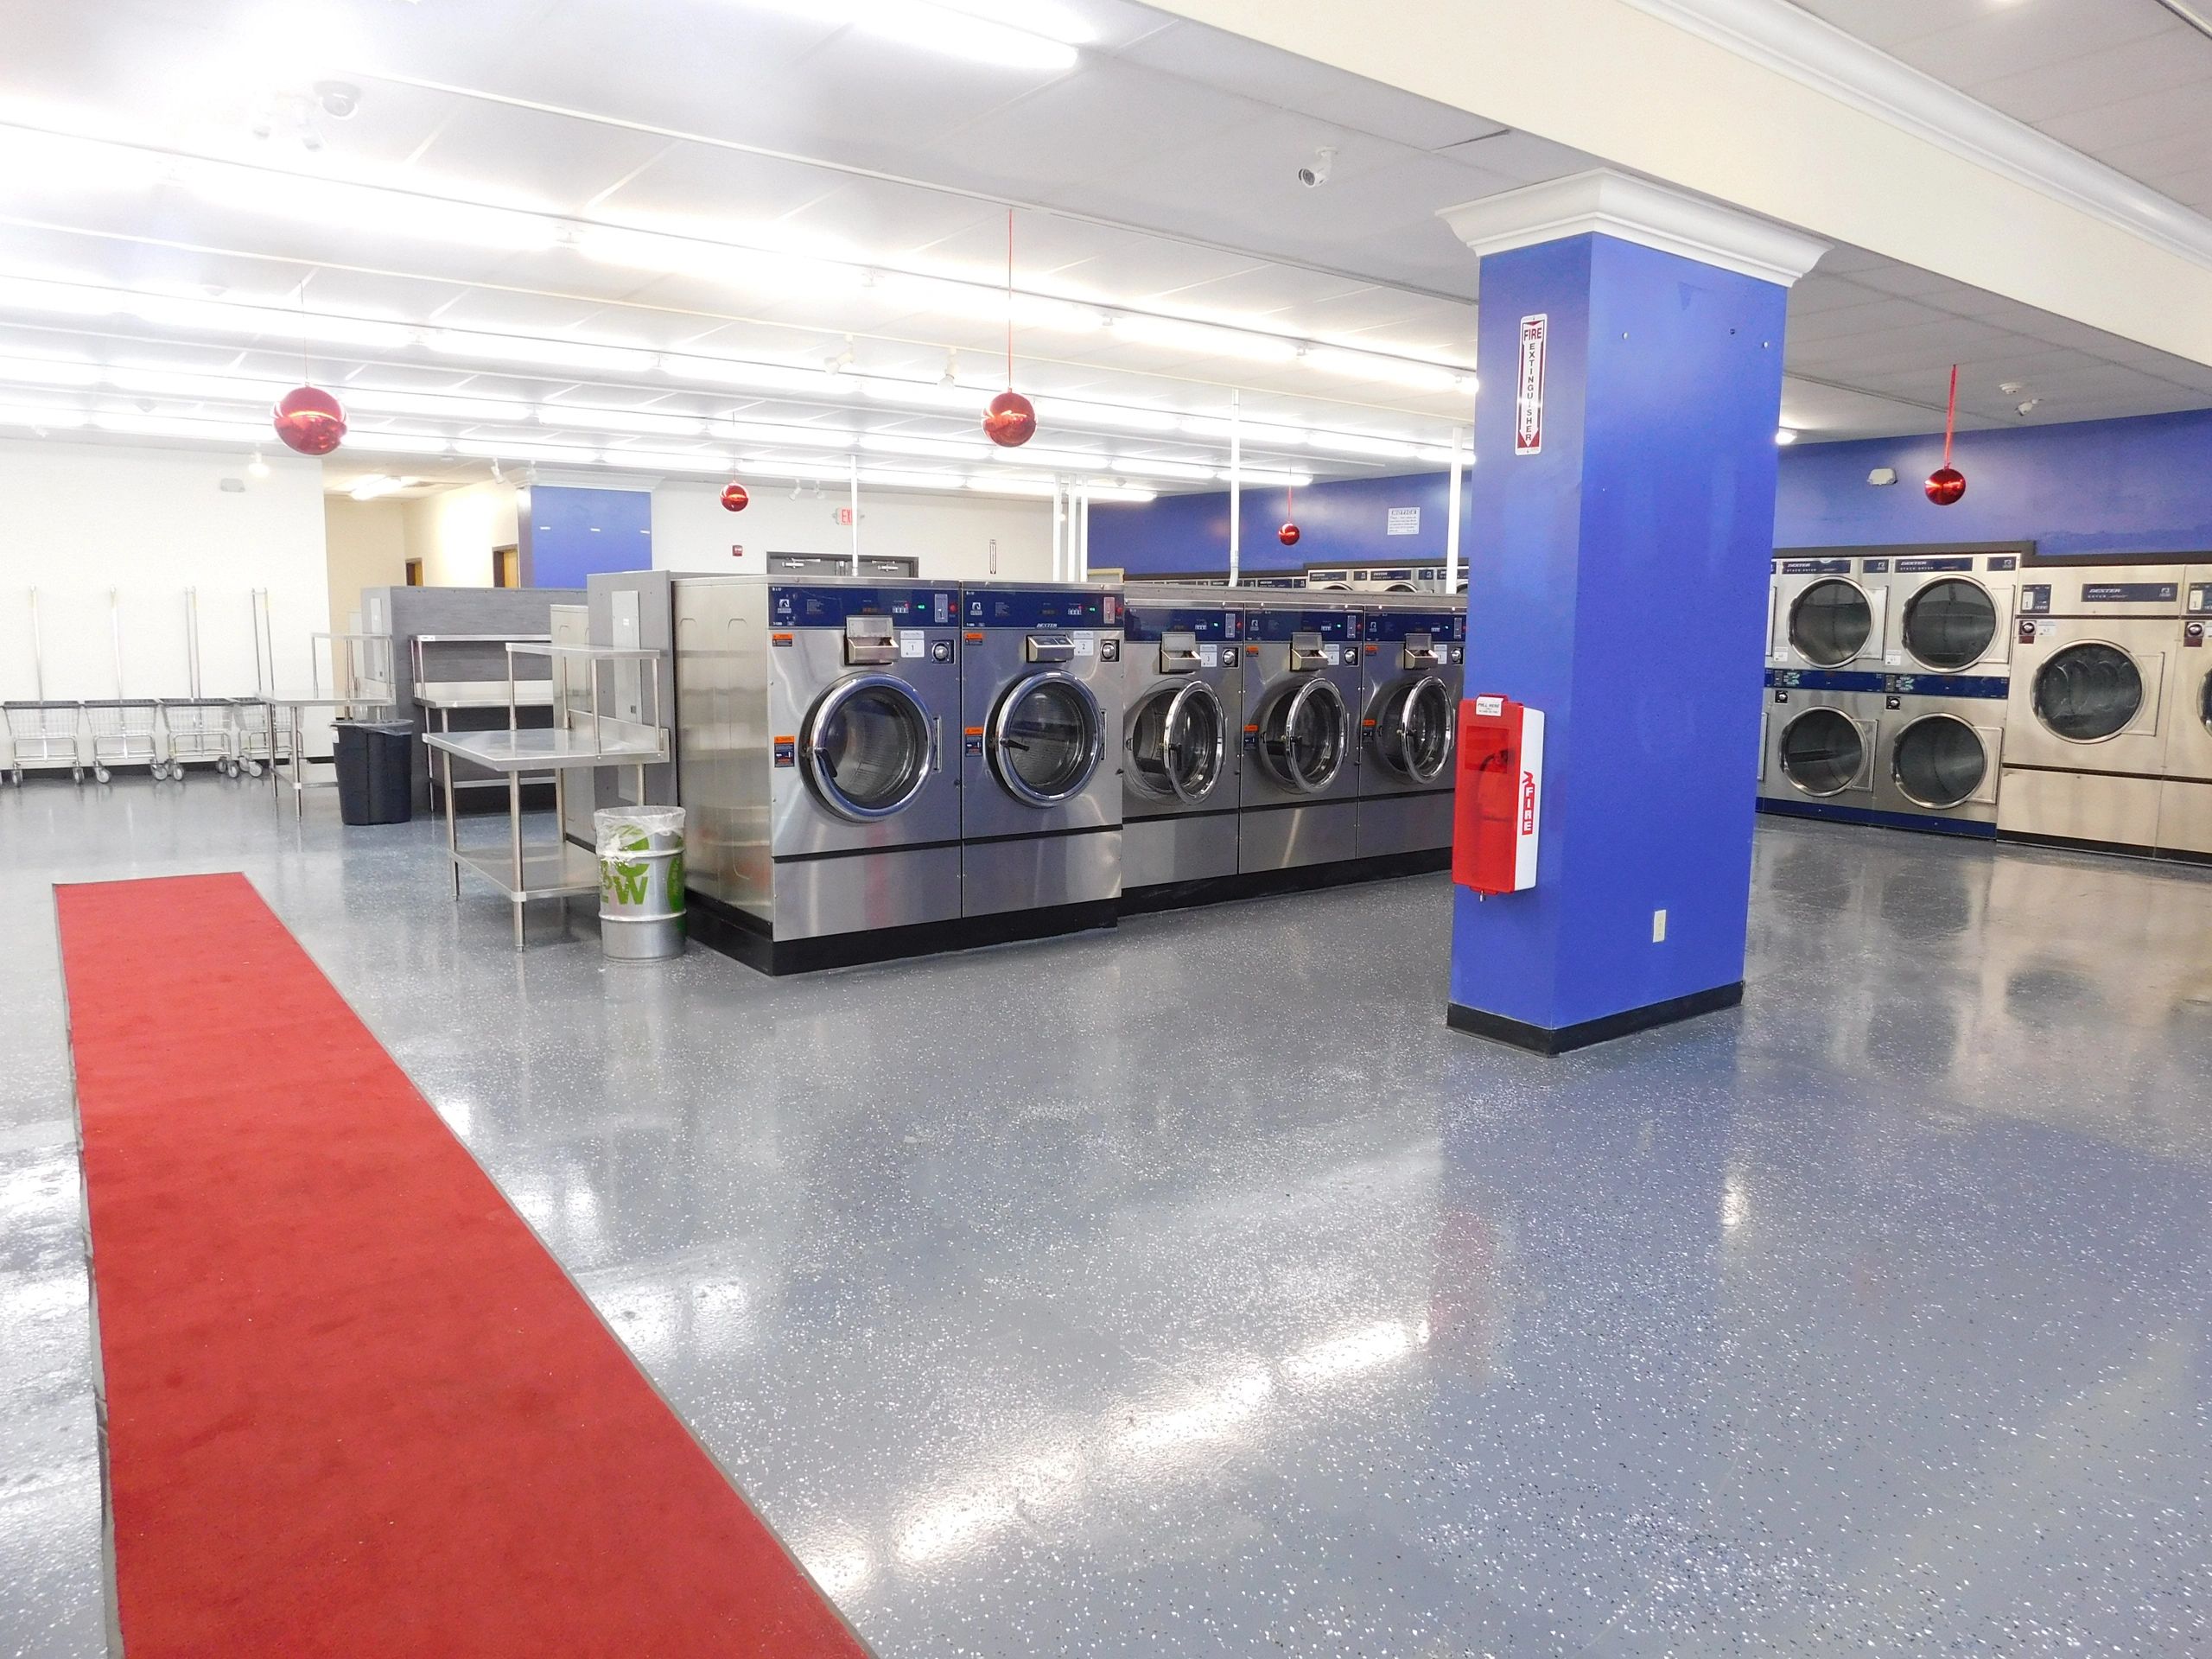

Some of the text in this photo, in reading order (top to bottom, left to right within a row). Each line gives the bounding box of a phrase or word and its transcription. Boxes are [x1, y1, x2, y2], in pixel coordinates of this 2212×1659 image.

[1523, 327, 1542, 341] FIRE
[1525, 342, 1535, 441] EXTINGUISHER
[1523, 786, 1534, 832] FIRE
